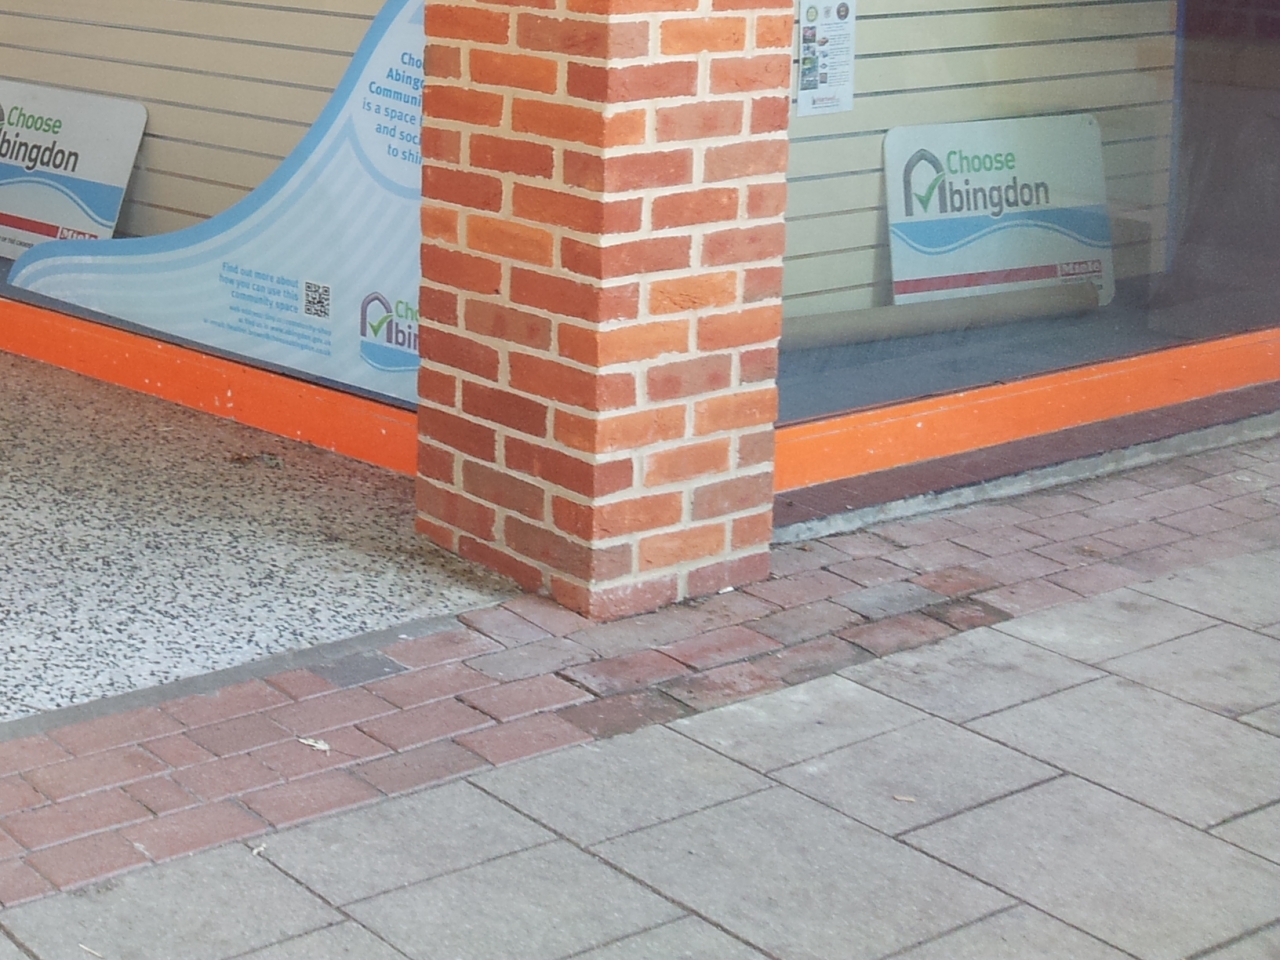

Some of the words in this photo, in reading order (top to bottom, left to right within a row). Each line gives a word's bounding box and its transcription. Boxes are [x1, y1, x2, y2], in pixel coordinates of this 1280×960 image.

[7, 105, 63, 135] Choose
[362, 97, 372, 112] is
[374, 104, 381, 114] a
[384, 106, 416, 125] space
[375, 123, 397, 138] and
[387, 143, 399, 158] to
[946, 149, 1016, 175] Choose
[903, 148, 1051, 218] Abingdon
